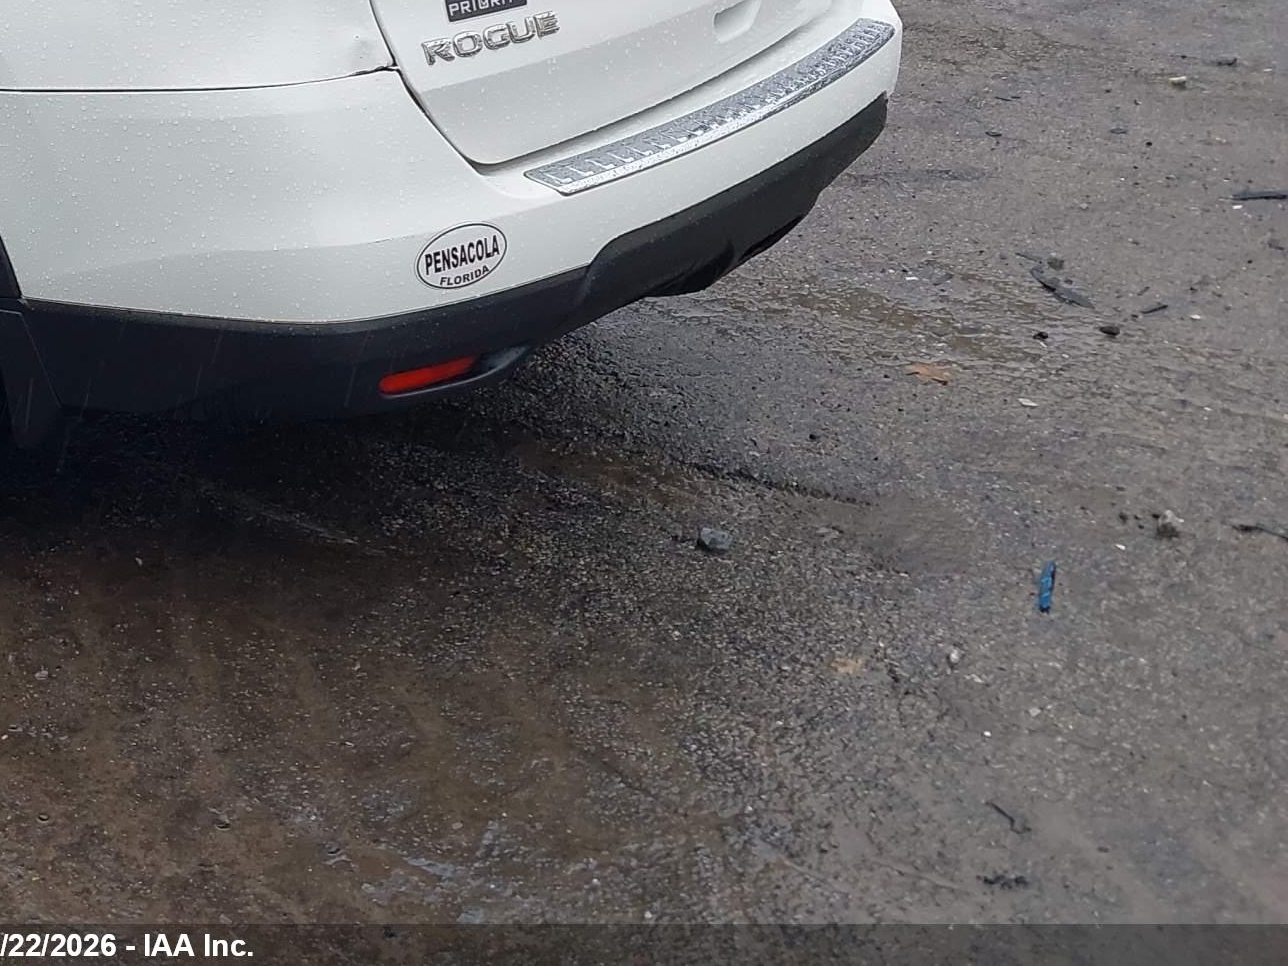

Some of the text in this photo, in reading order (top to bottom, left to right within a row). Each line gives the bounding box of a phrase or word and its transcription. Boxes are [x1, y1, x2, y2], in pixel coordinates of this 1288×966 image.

[421, 11, 560, 66] ROGUE
[424, 235, 500, 275] PENSACOLA
[439, 265, 490, 286] FLORIDA
